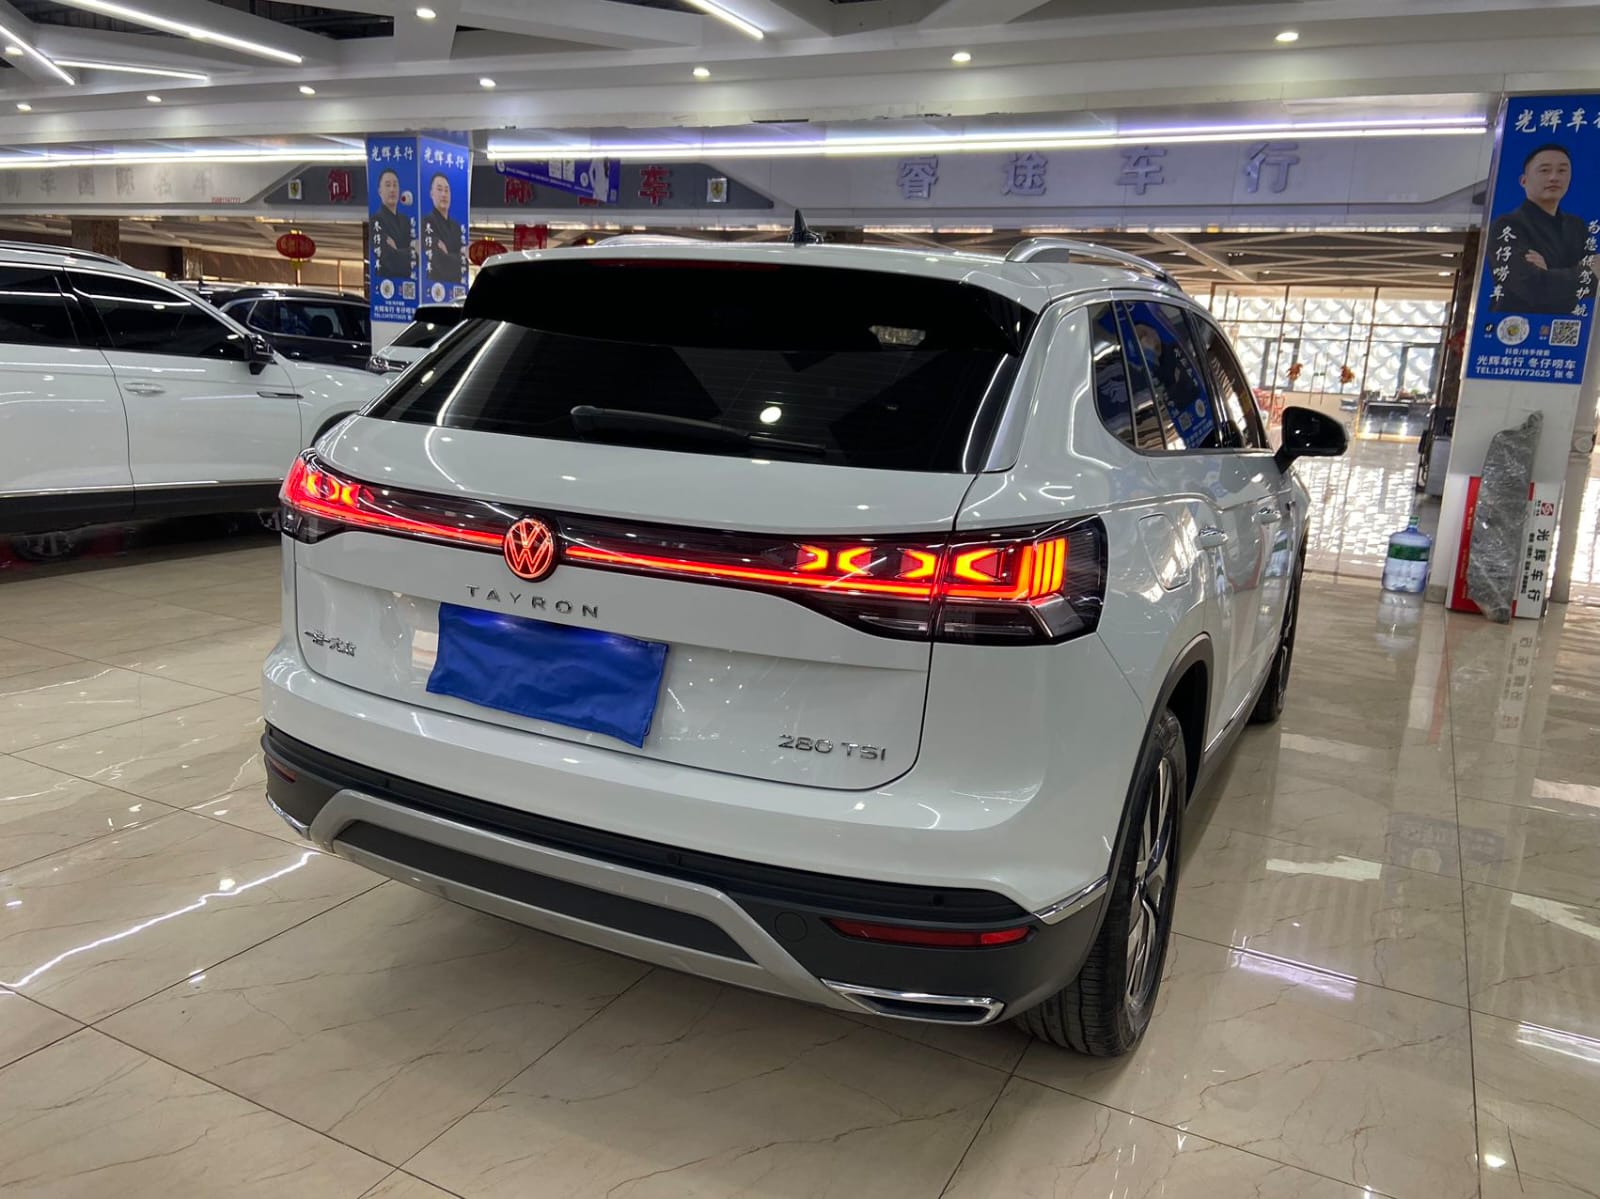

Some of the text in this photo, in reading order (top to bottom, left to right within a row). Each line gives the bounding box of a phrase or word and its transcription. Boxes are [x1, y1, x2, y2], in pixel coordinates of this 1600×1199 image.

[1476, 355, 1525, 368] 光辉车行
[466, 584, 600, 619] TAYRON
[778, 734, 887, 761] 280 TSI
